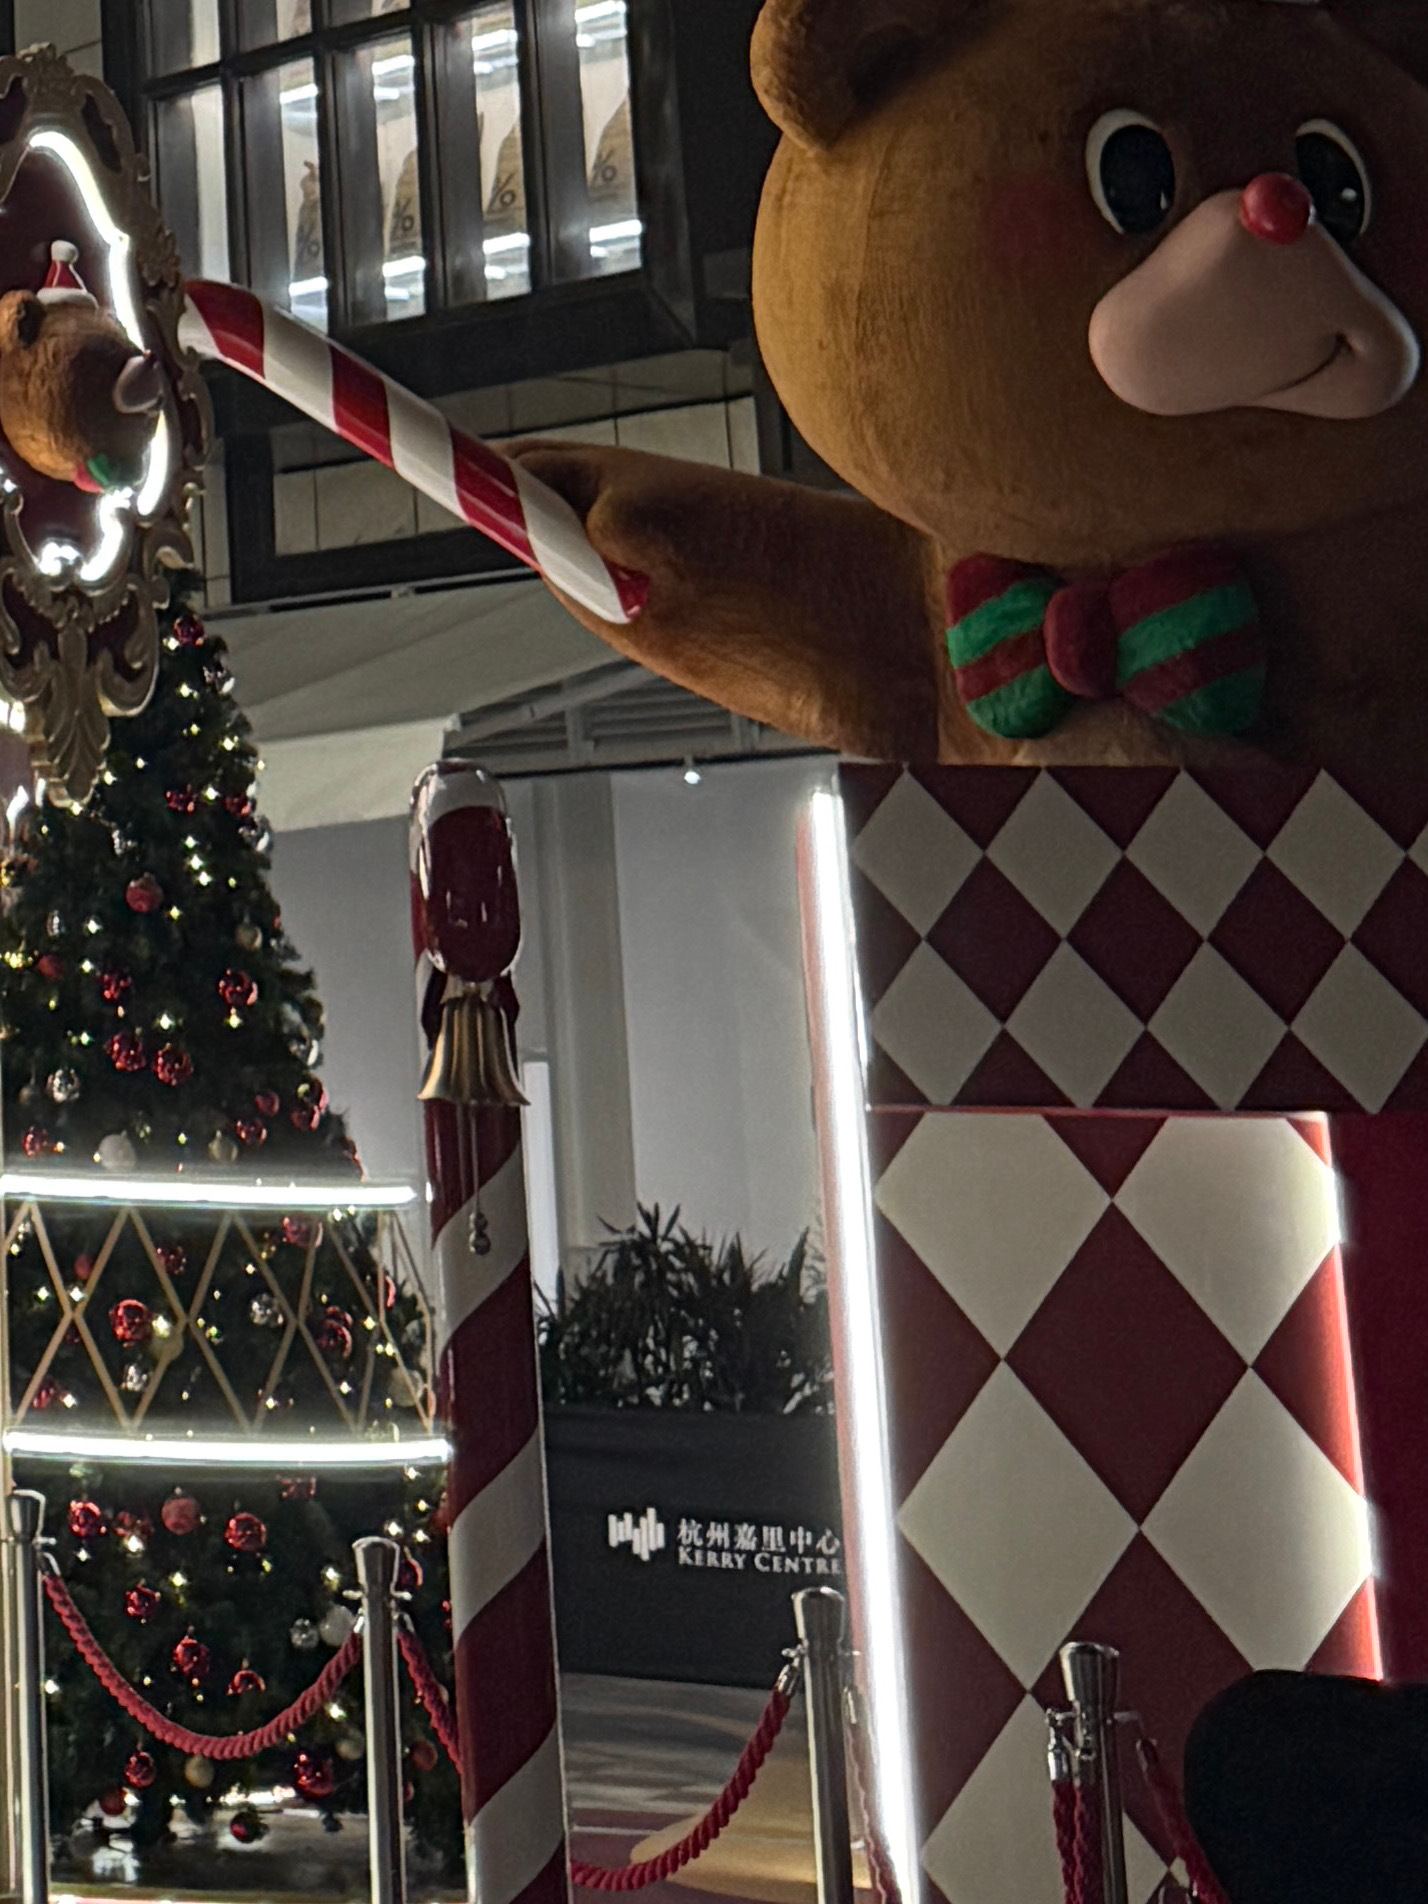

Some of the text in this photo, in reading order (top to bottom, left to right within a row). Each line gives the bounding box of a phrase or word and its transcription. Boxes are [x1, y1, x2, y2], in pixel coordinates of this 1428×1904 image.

[678, 1518, 840, 1554] 杭州嘉里中心
[679, 1547, 841, 1574] KERRY CENTRE
